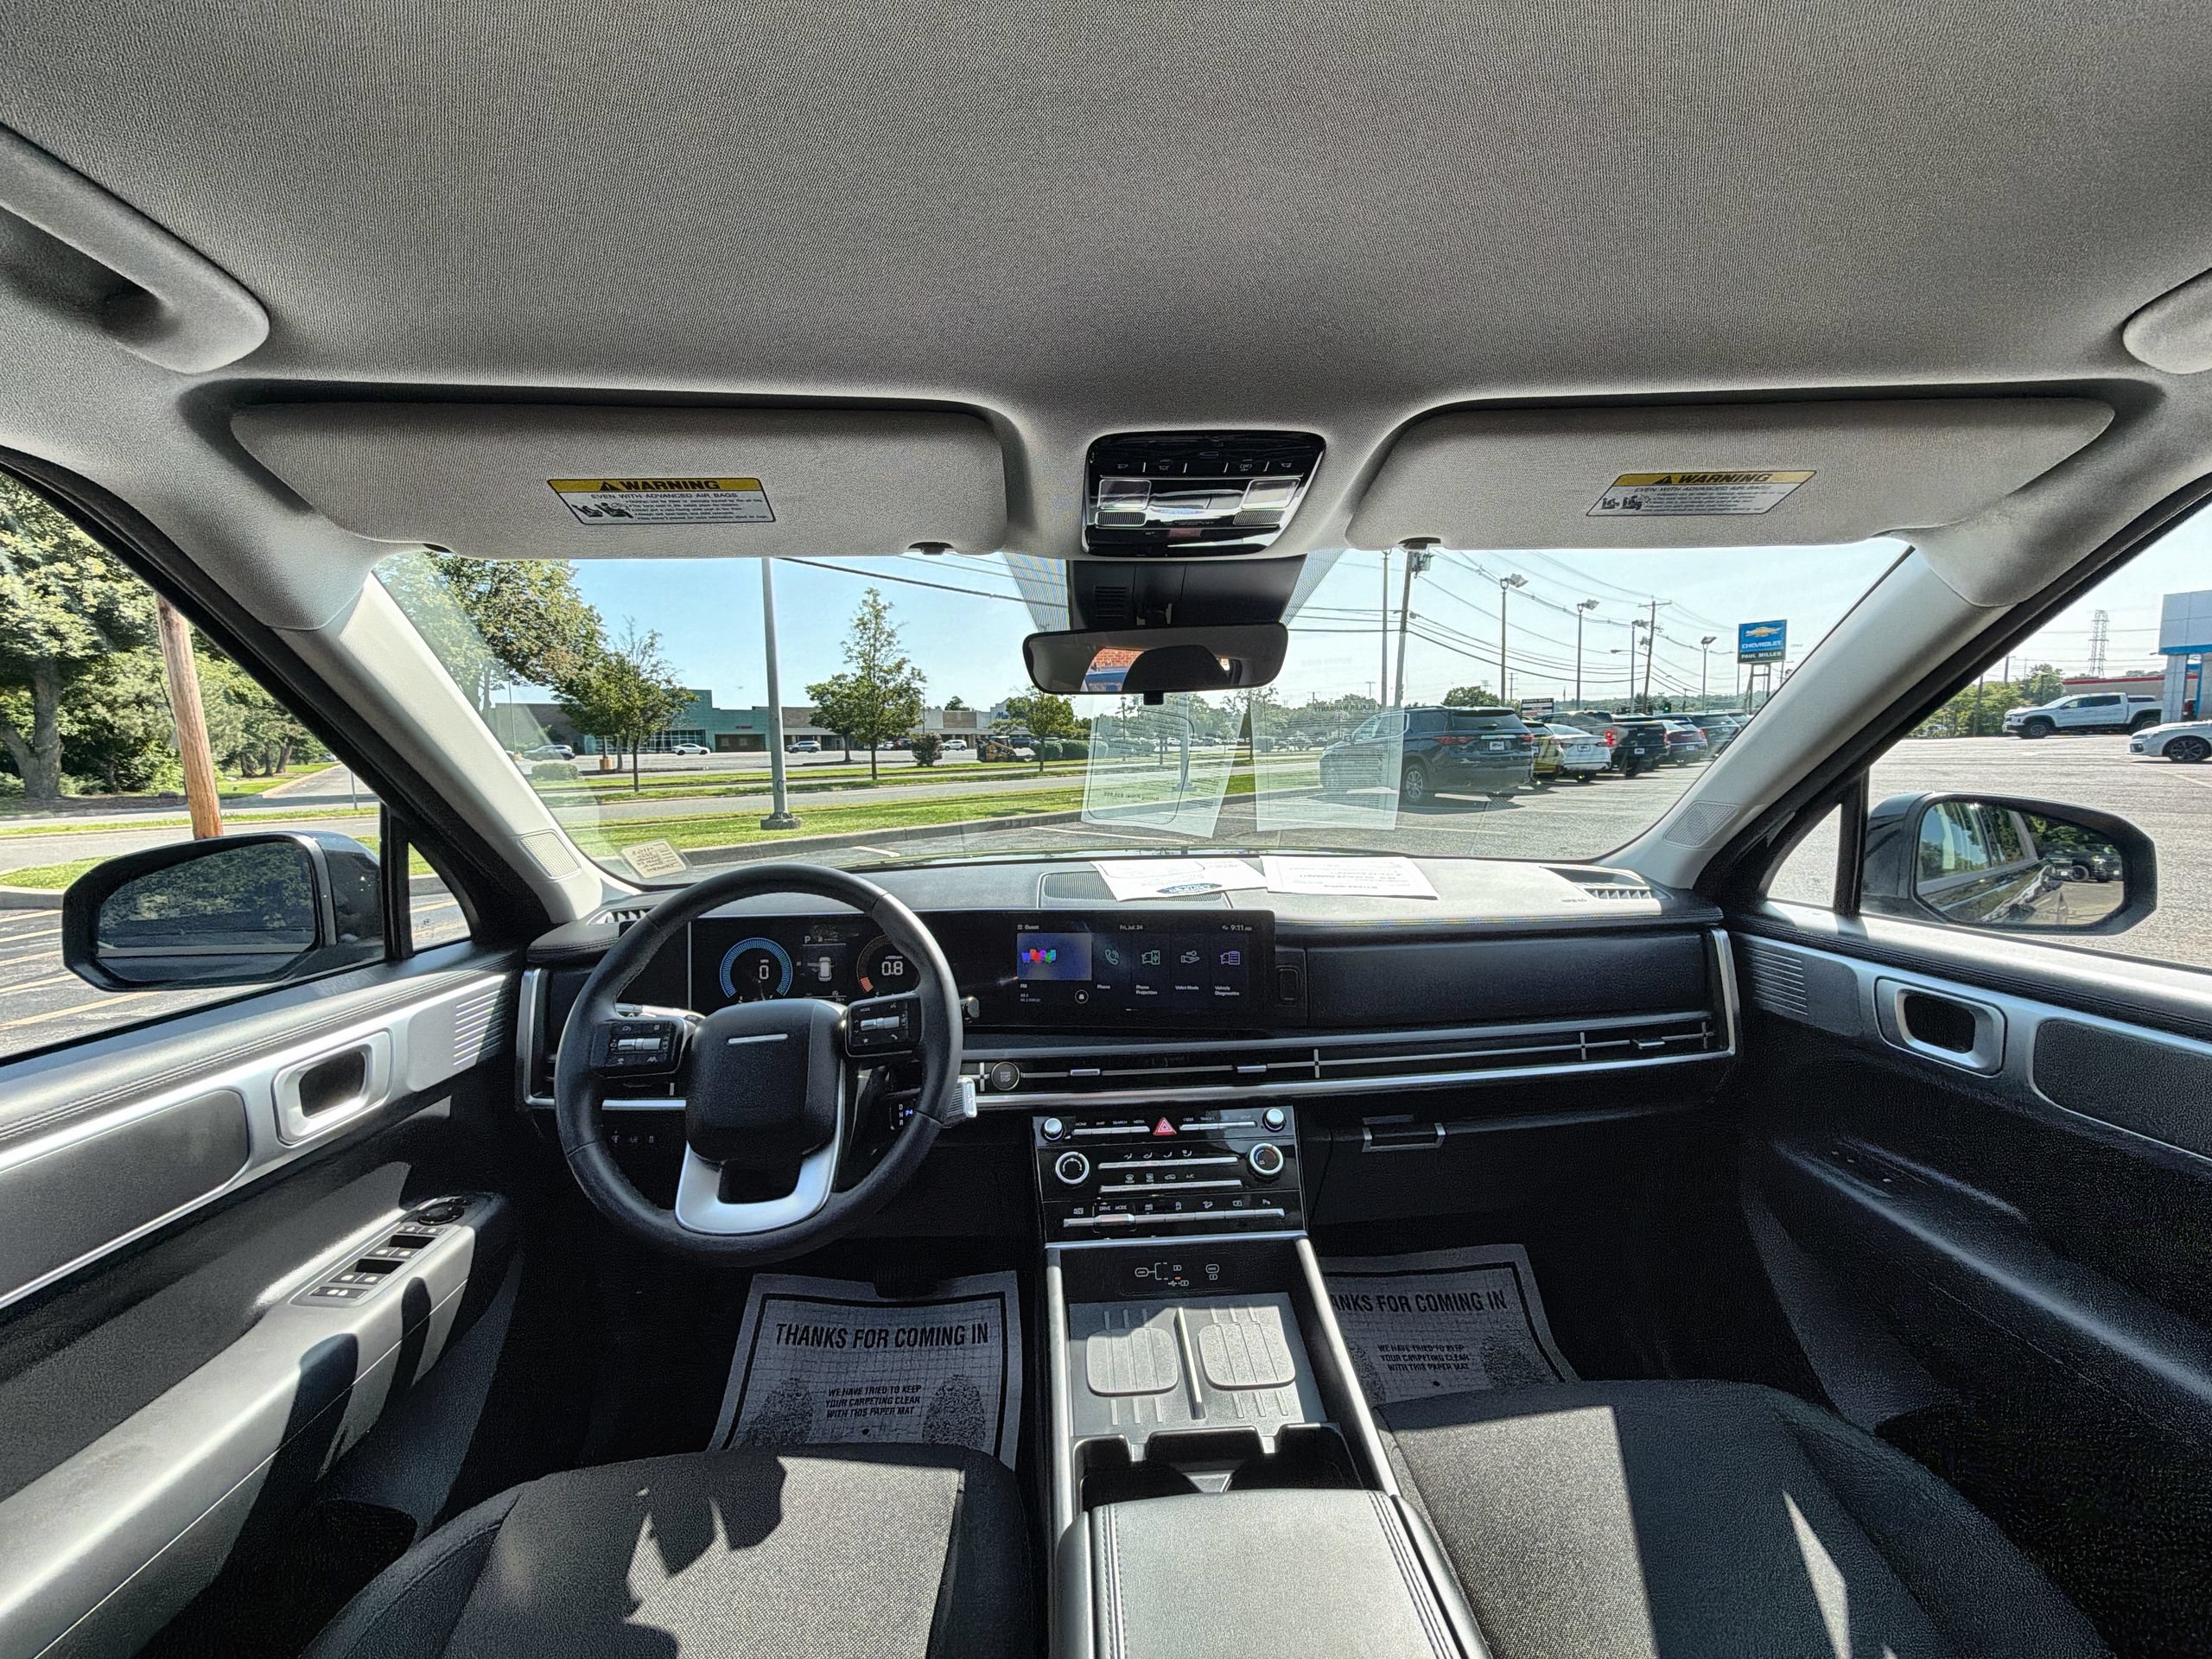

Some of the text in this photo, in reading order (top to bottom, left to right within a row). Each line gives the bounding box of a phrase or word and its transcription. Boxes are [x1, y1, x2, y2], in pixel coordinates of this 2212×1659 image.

[1677, 473, 1771, 483] WARNING
[620, 480, 721, 491] WARNING
[1741, 640, 1782, 649] CHEVROLET
[804, 935, 810, 944] P
[759, 965, 769, 980] 0
[881, 961, 904, 976] 0.8
[1329, 1290, 1508, 1313] ANKS FOR COMING IN
[776, 1322, 988, 1349] THANKS FOR COMING IN
[1387, 1363, 1409, 1372] WITH
[1427, 1363, 1452, 1371] PAPER
[828, 1384, 922, 1397] WE HAVE TRIED TO KEEP
[825, 1395, 921, 1408] YOUR CARPETING CLEAN
[826, 1406, 915, 1419] WITH THIS PAPER MAT
